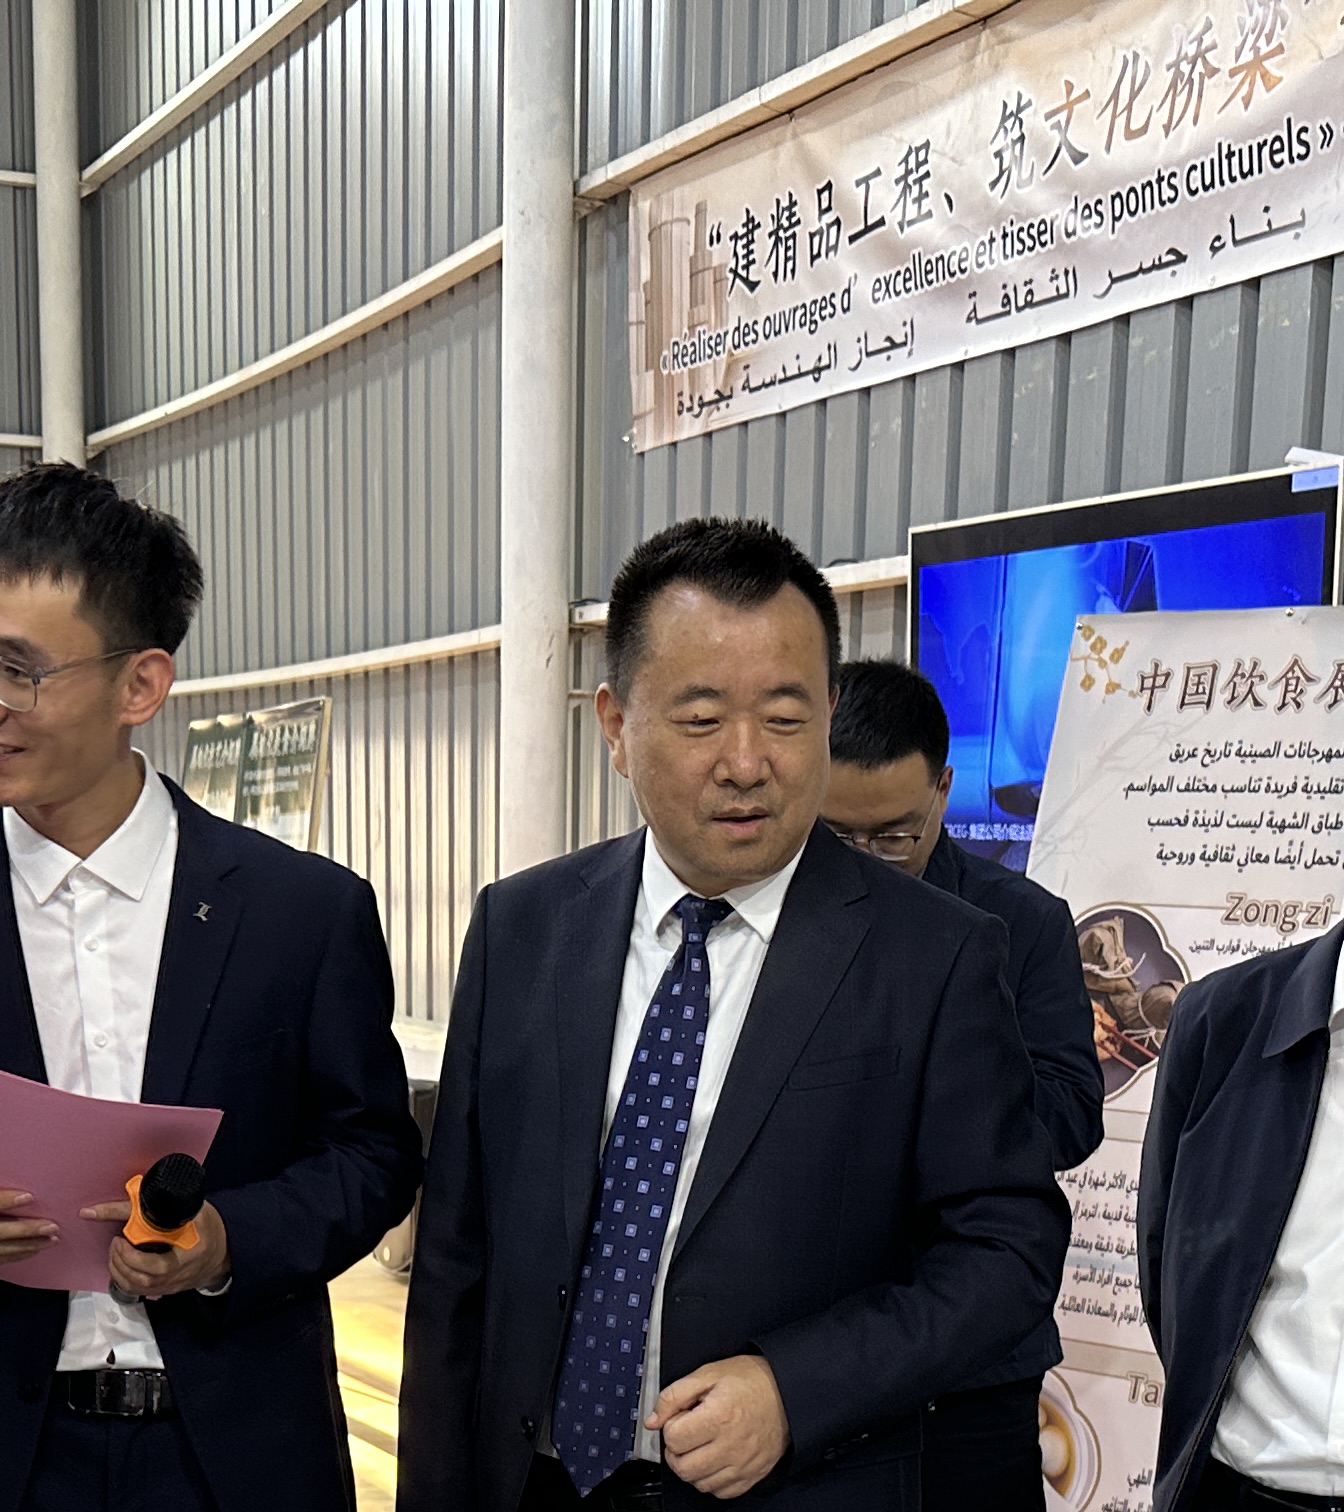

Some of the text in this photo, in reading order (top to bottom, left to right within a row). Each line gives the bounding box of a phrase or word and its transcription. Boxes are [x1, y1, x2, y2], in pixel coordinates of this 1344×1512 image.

[671, 329, 728, 372] Réaliser
[731, 316, 759, 352] des
[762, 292, 838, 341] ouvrages
[871, 248, 969, 304] excellence
[974, 229, 997, 270] et
[1001, 217, 1059, 260] tisser
[1063, 195, 1104, 240] des
[1110, 166, 1180, 234] ponts
[1184, 116, 1312, 193] culturels
[1208, 204, 1307, 259] بناء
[1092, 246, 1189, 299] جسر
[964, 265, 1079, 325] الثقافة
[849, 317, 916, 372] إنجاز
[740, 341, 838, 395] الهندسة
[675, 385, 734, 419] بجودة
[1168, 744, 1199, 765] عريق
[1200, 740, 1233, 768] تاريخ
[1234, 740, 1282, 766] الصينية
[1175, 775, 1218, 796] مختلف
[1220, 775, 1261, 800] تناسب
[1263, 776, 1298, 799] فريدة
[1147, 808, 1190, 833] فحسب
[1191, 810, 1224, 834] لذيذة
[1226, 810, 1265, 835] ليست
[1265, 810, 1308, 835] الشهية
[1155, 843, 1197, 867] وروحية
[1198, 843, 1237, 867] ثقافية
[1303, 846, 1340, 869] تحمل
[1223, 892, 1333, 934] Zong zi
